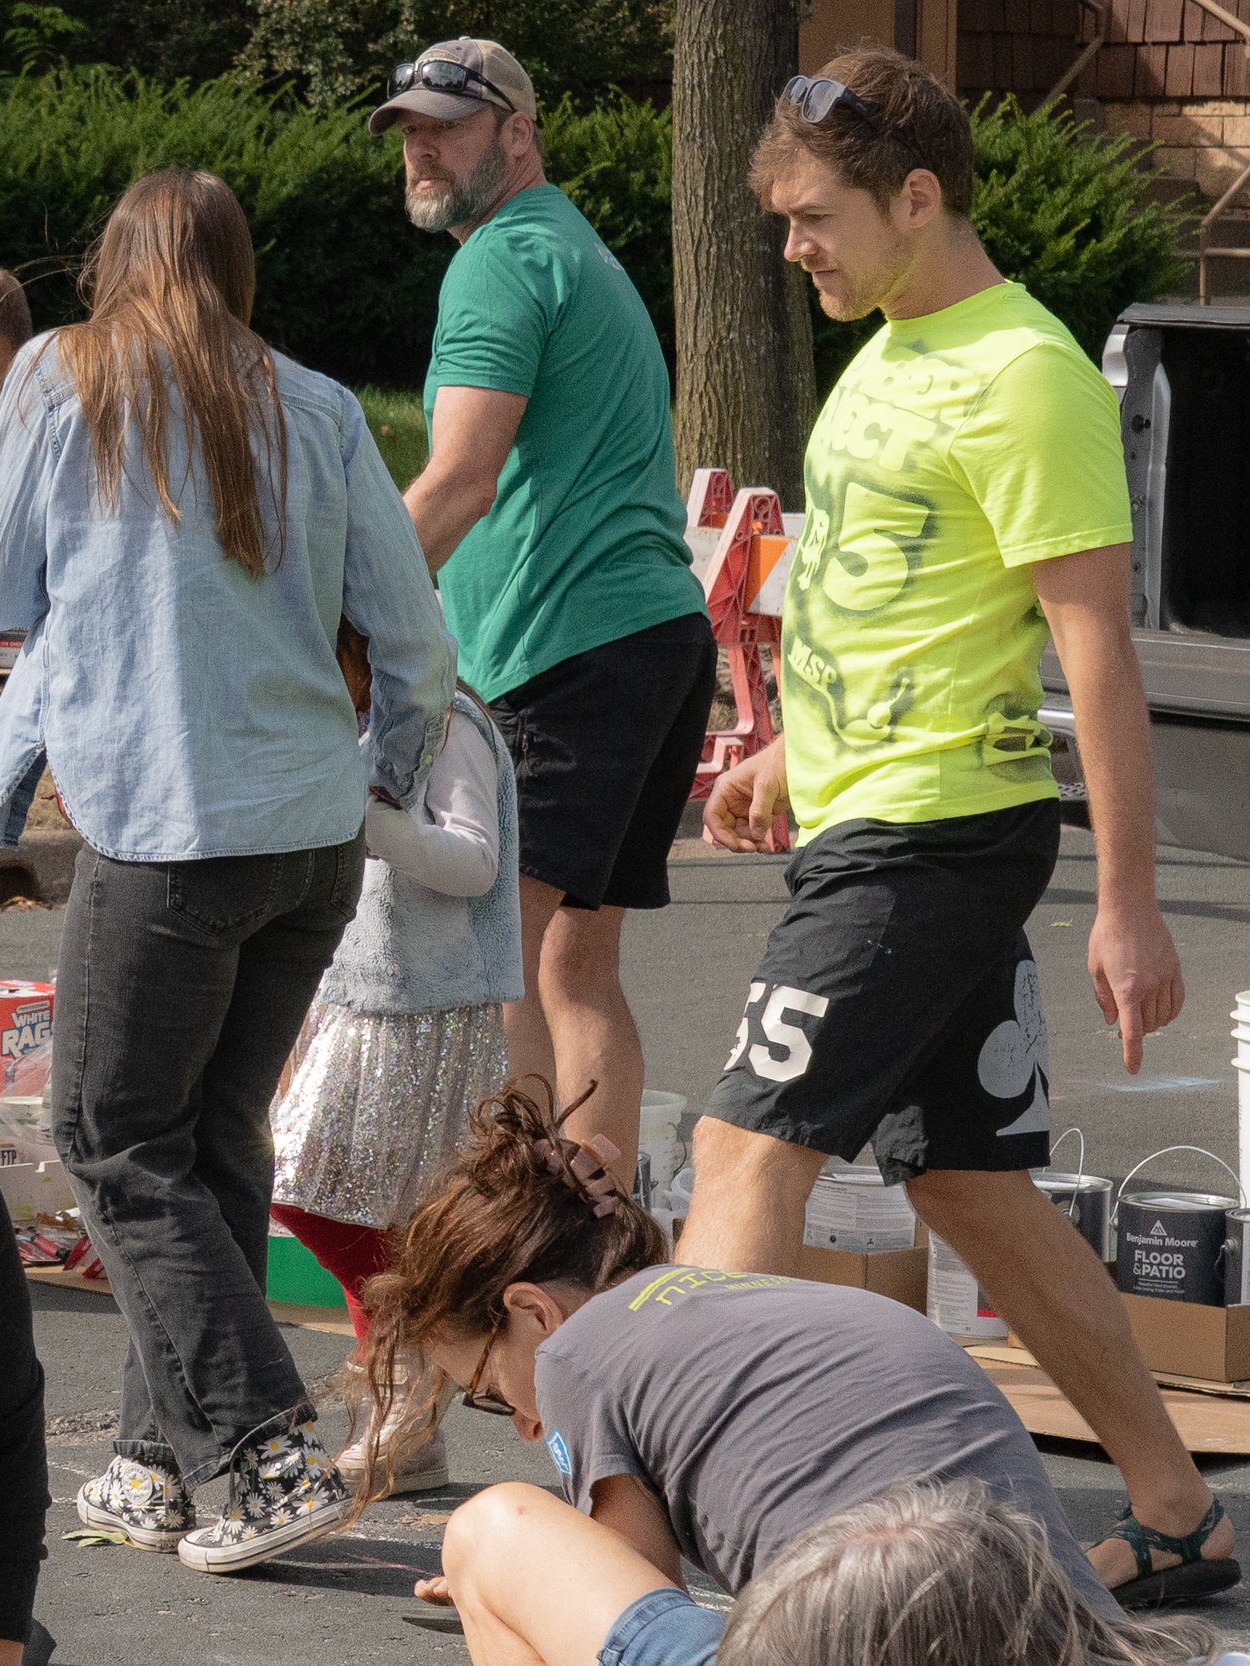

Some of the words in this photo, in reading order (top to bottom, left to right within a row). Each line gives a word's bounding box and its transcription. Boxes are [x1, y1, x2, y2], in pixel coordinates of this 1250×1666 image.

[11, 1009, 51, 1028] WHITE
[0, 1022, 53, 1060] RAG
[1126, 1232, 1163, 1246] Benjamin
[1164, 1237, 1198, 1248] Moore
[1134, 1249, 1184, 1266] FLOOR
